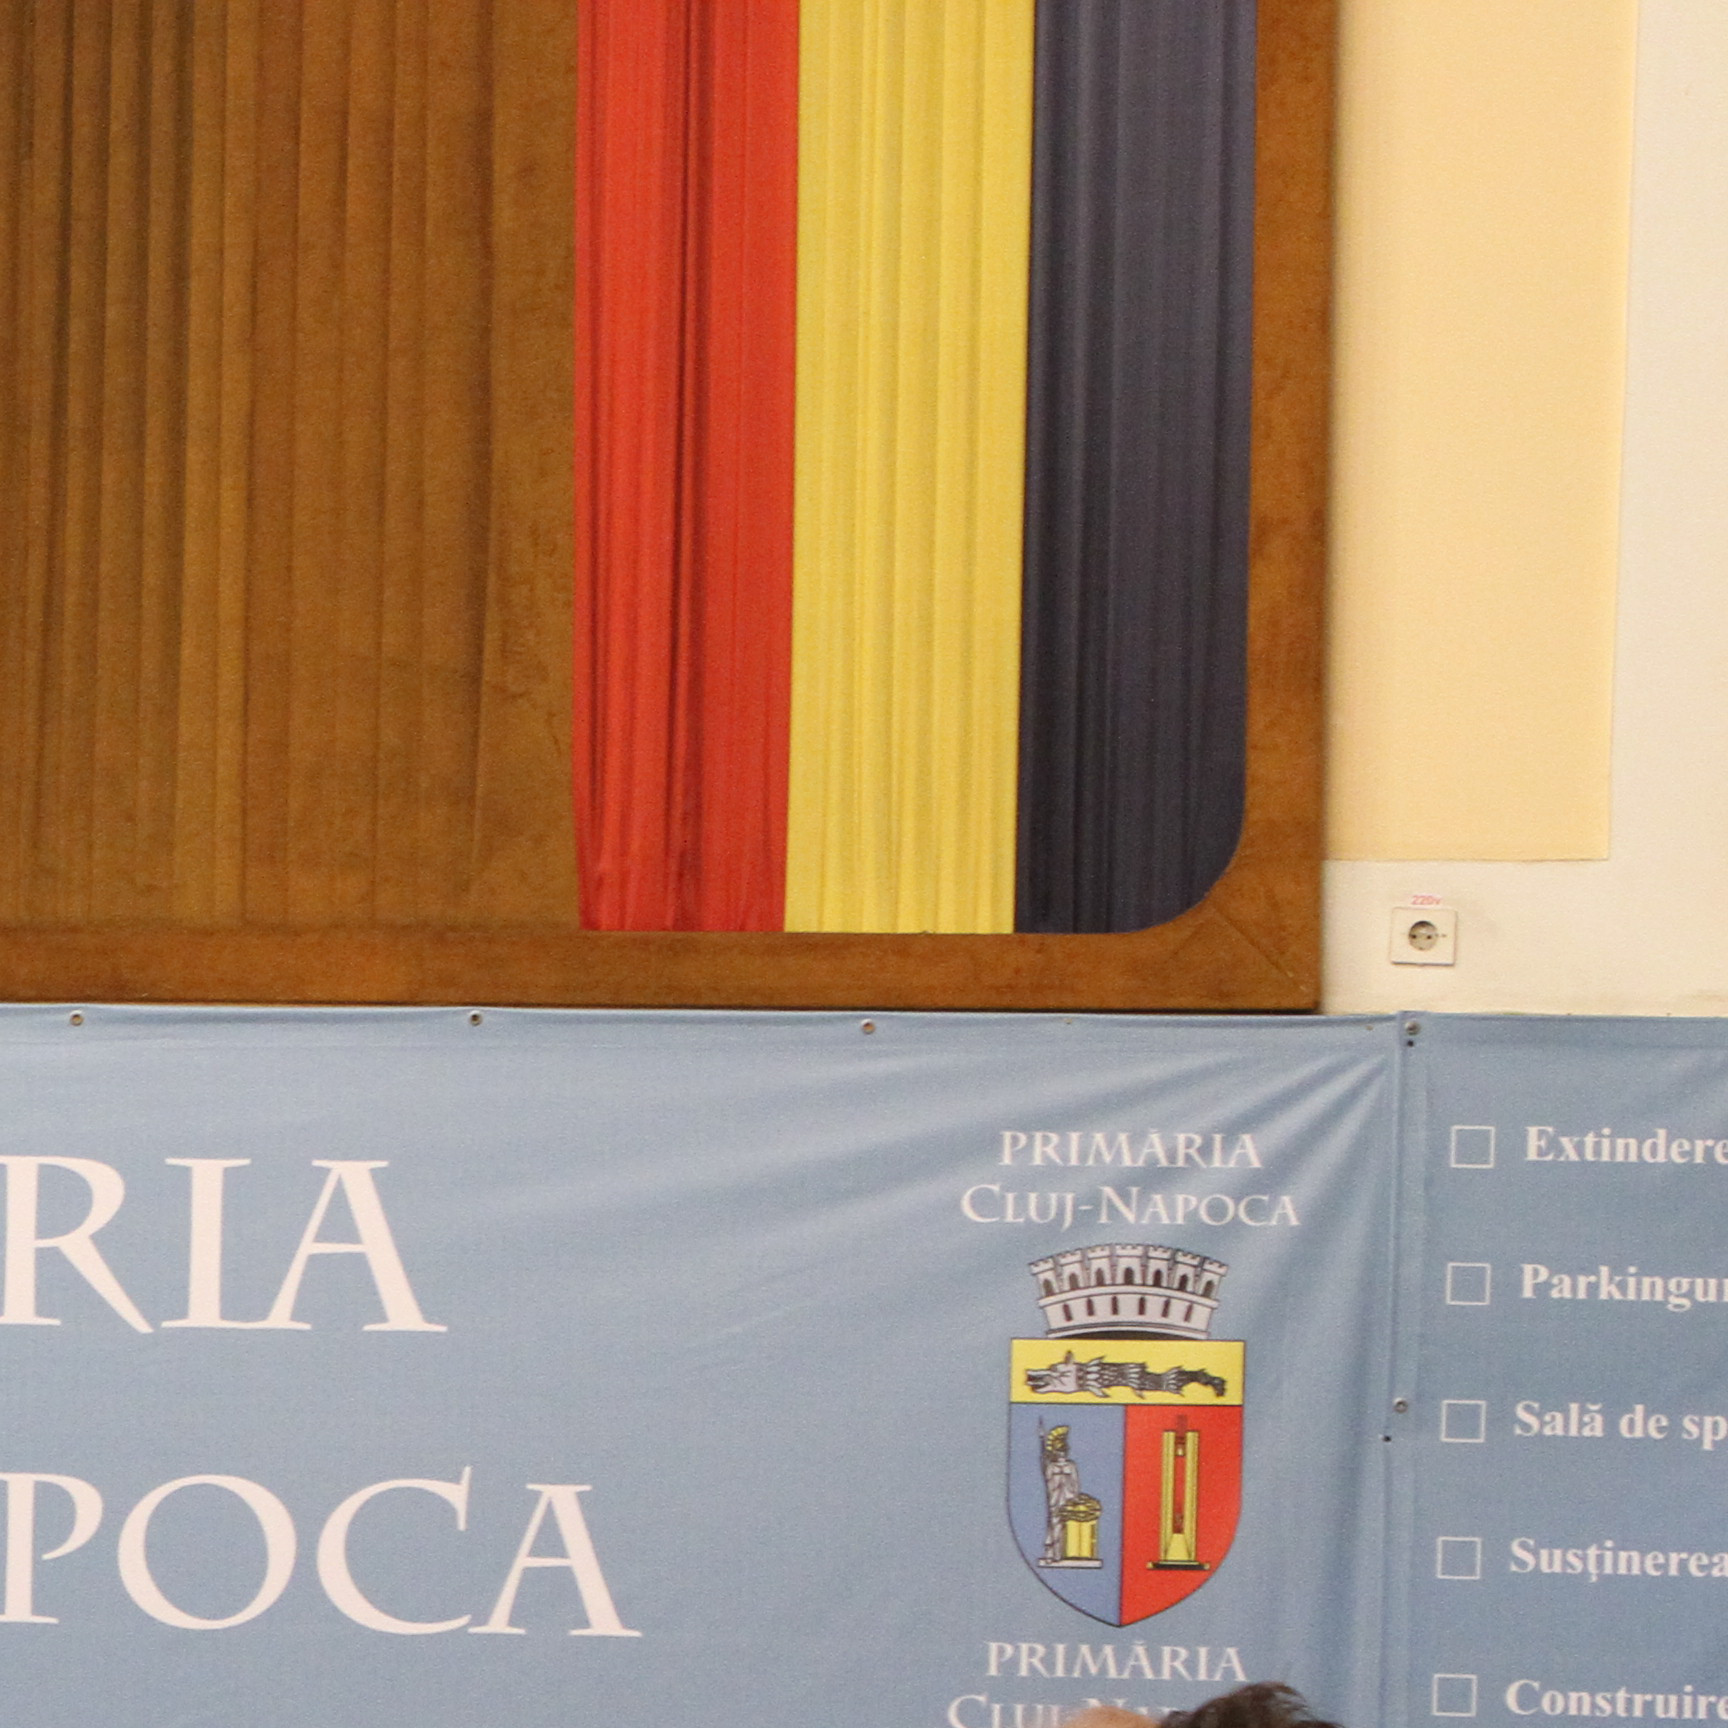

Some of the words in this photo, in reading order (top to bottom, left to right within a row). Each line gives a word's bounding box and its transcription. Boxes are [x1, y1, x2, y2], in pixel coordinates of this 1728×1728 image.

[998, 1129, 1262, 1169] PRIMĂRIA
[1525, 1126, 1728, 1164] Extindere
[1514, 1401, 1604, 1437] Sală
[1619, 1404, 1669, 1440] de
[985, 1641, 1247, 1682] PRIMĂRIA
